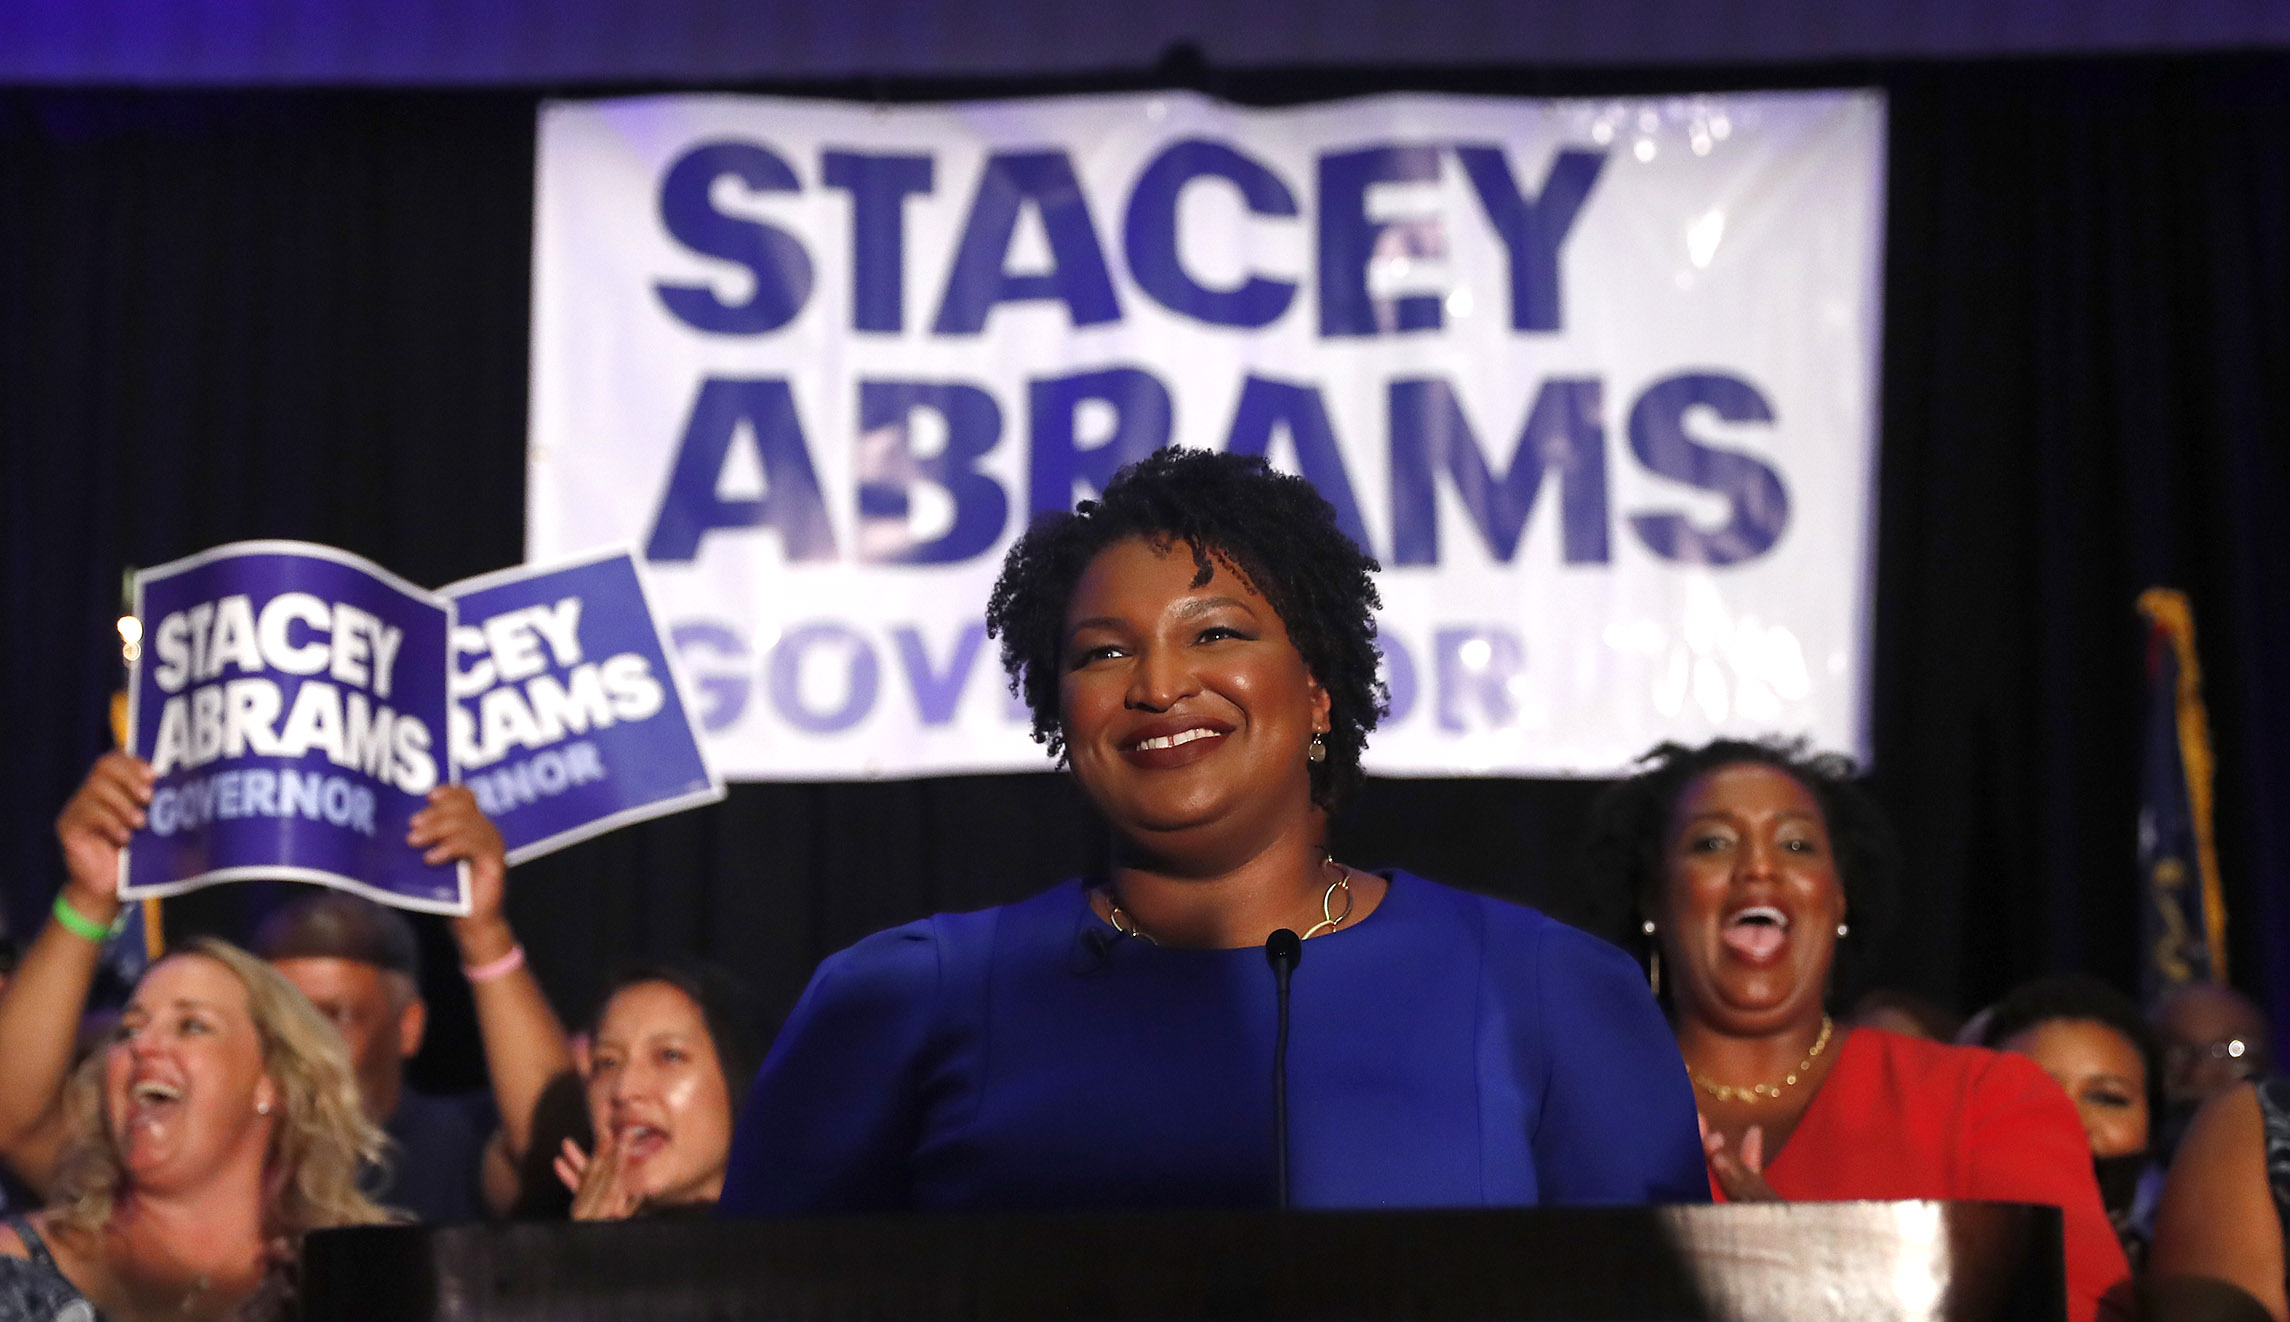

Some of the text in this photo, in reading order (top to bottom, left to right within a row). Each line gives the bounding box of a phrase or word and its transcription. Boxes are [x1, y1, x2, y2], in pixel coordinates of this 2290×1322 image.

[653, 137, 1609, 338] STACEY
[645, 366, 1792, 567] ABRAMS
[154, 592, 402, 698] STACEY
[450, 596, 582, 699] CEY
[151, 677, 438, 796] ABRAMS
[450, 653, 666, 770] RAMS
[150, 767, 376, 837] GOVERNOR
